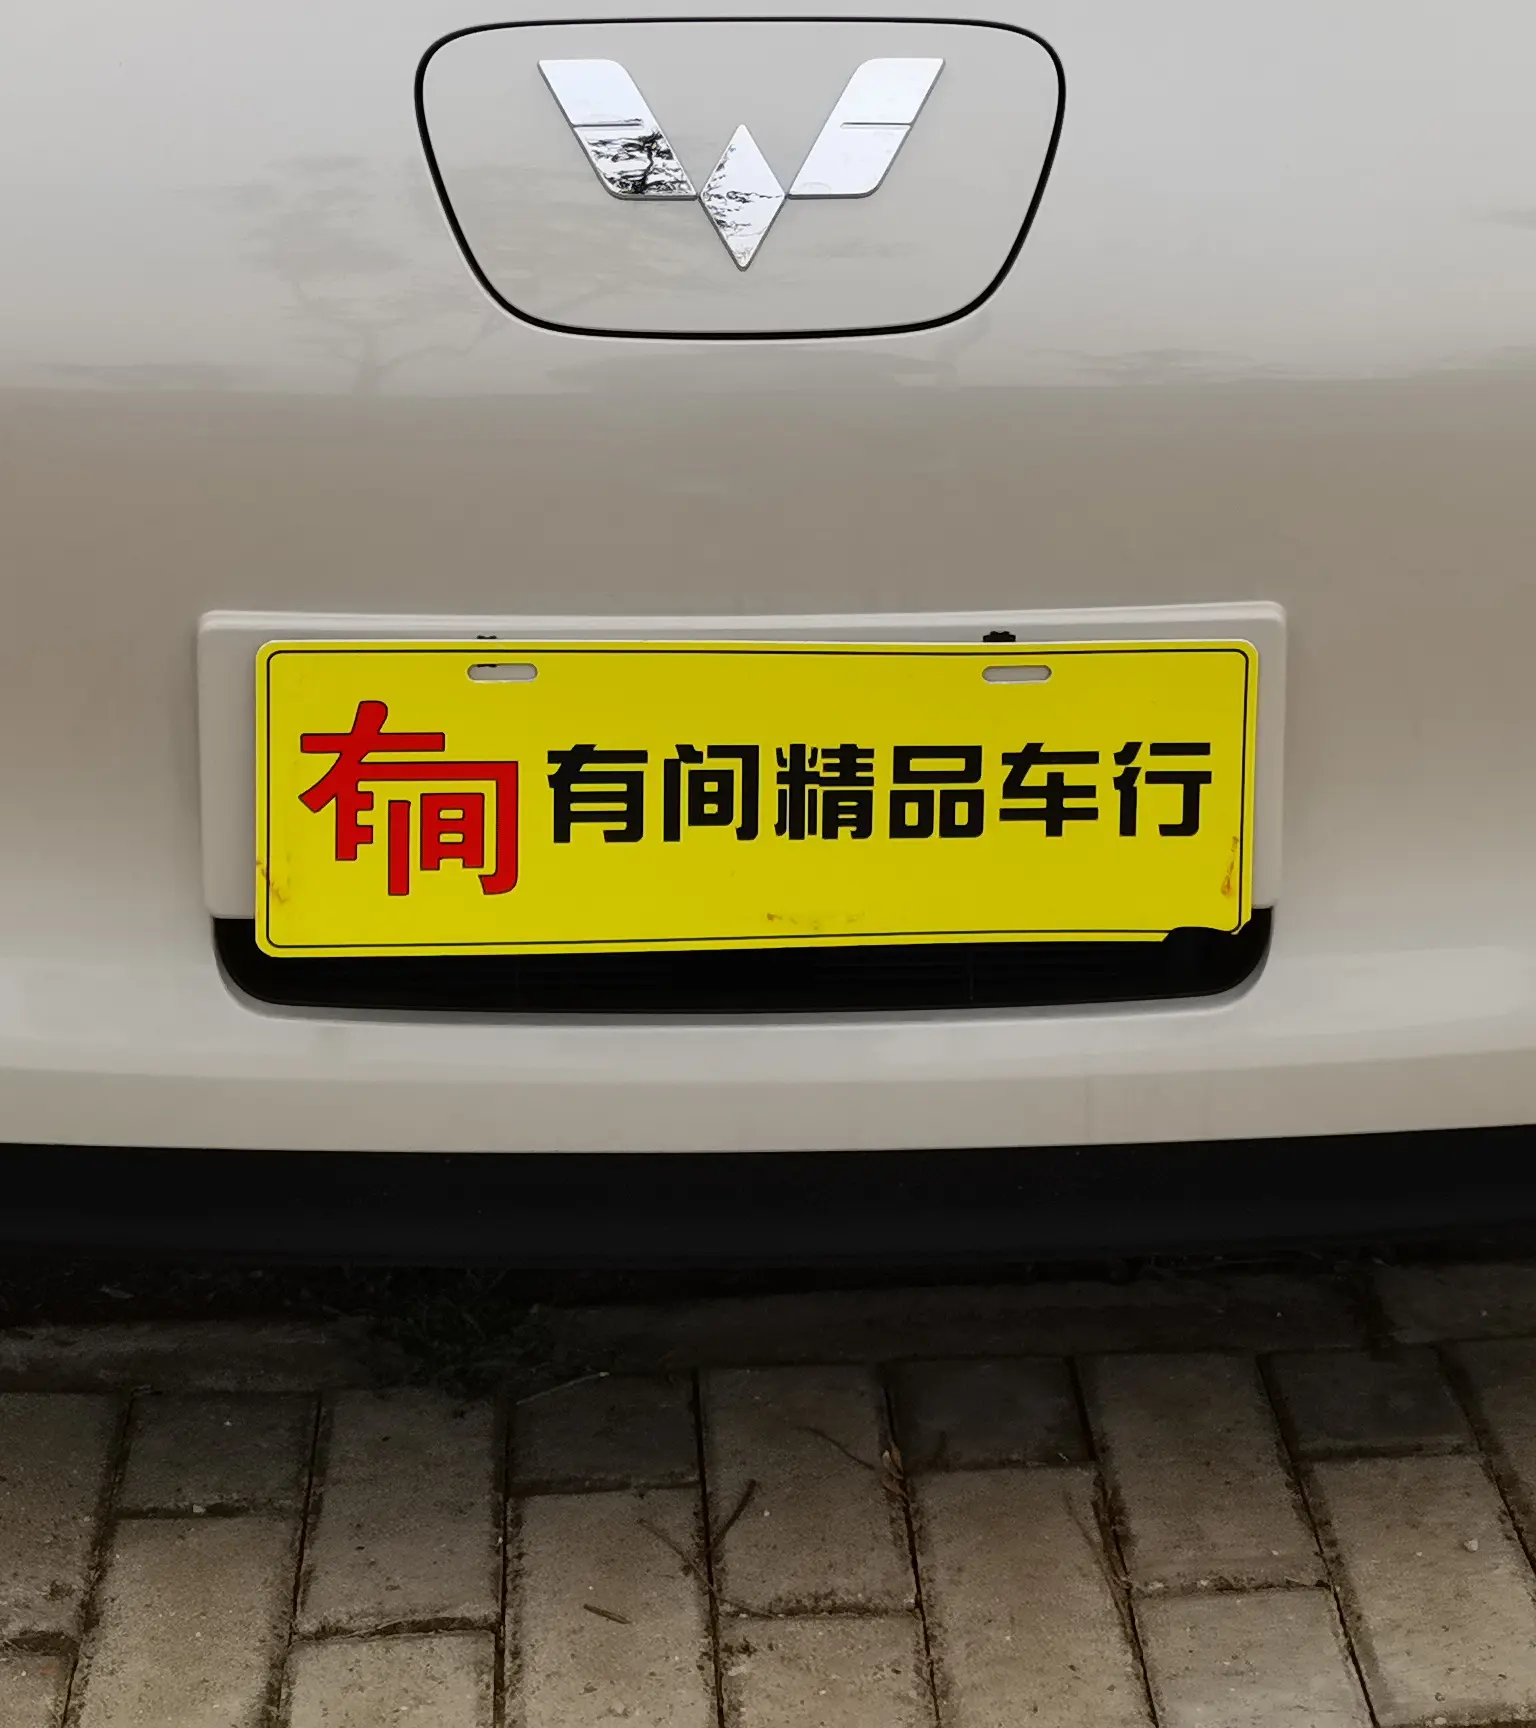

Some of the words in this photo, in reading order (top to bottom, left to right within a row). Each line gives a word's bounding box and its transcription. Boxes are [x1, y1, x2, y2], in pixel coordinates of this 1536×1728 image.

[545, 740, 1213, 845] 有间精品车行
